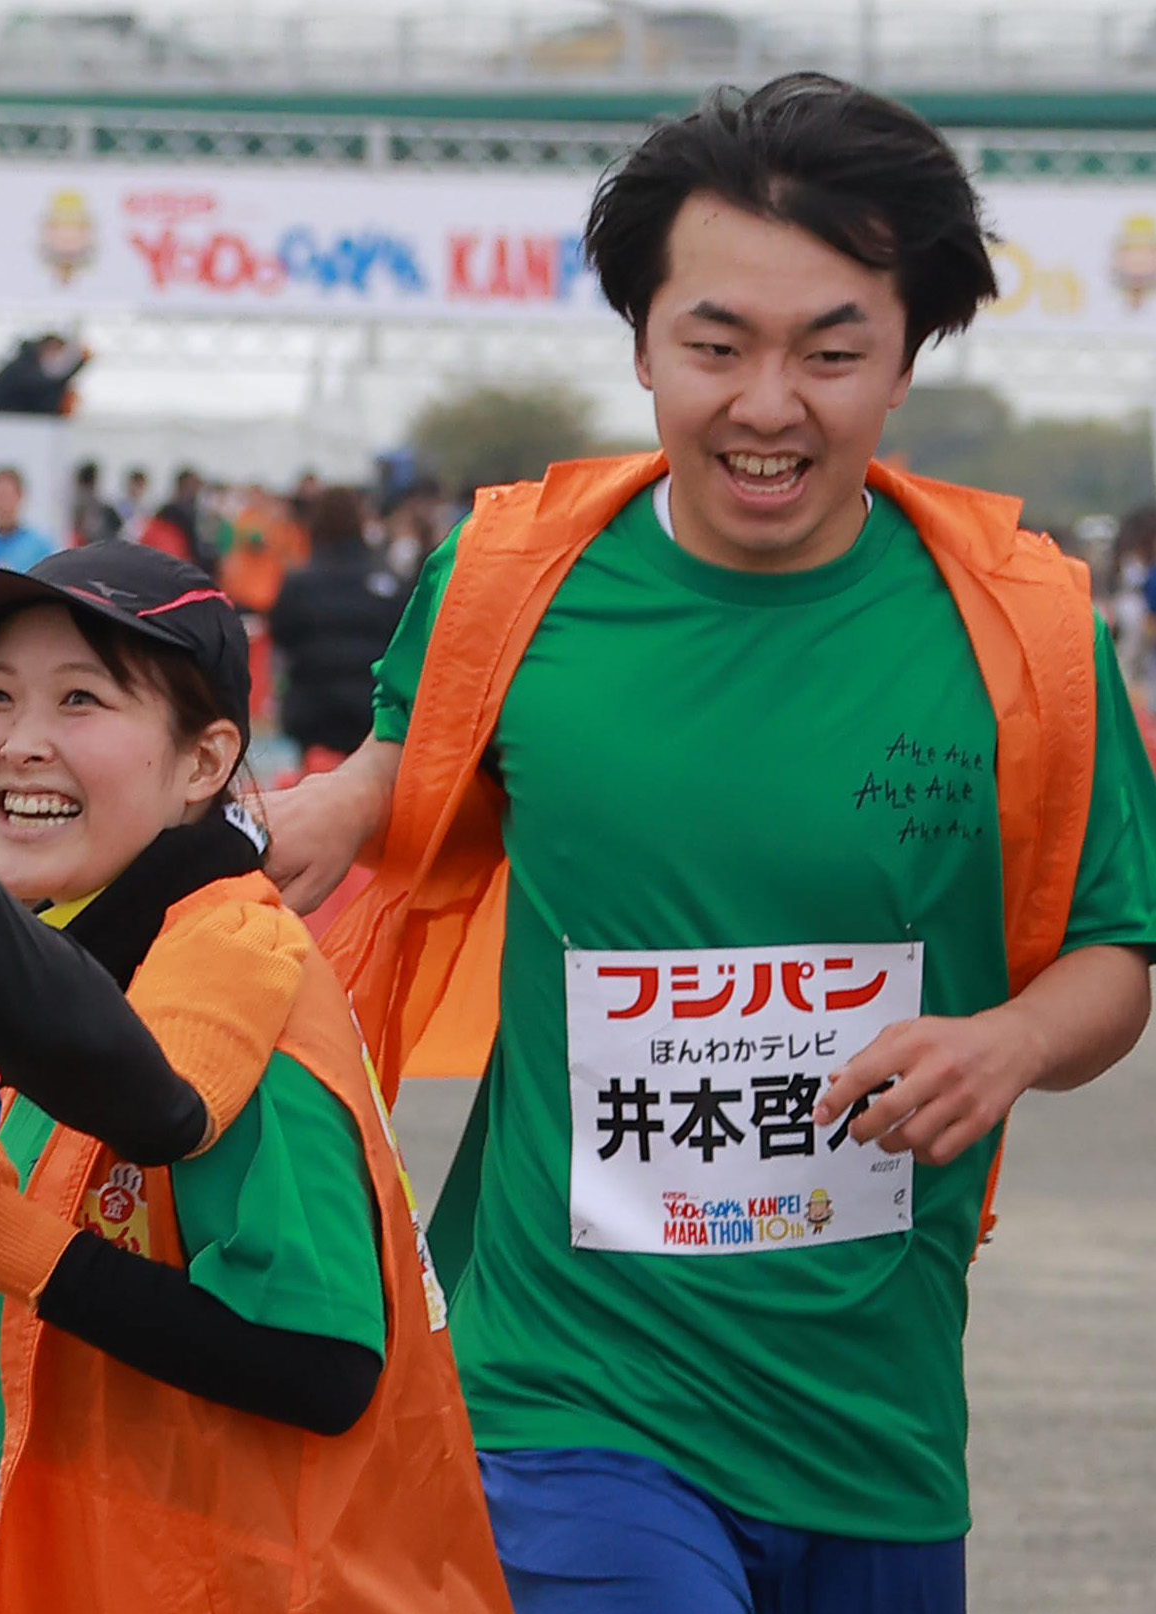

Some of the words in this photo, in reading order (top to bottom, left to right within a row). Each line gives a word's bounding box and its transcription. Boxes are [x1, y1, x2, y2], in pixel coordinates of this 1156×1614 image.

[597, 958, 888, 1020] フジパン
[650, 1030, 838, 1064] ほんわかテレビ
[748, 1194, 801, 1217] KANPEI
[663, 1220, 753, 1246] MARATHON
